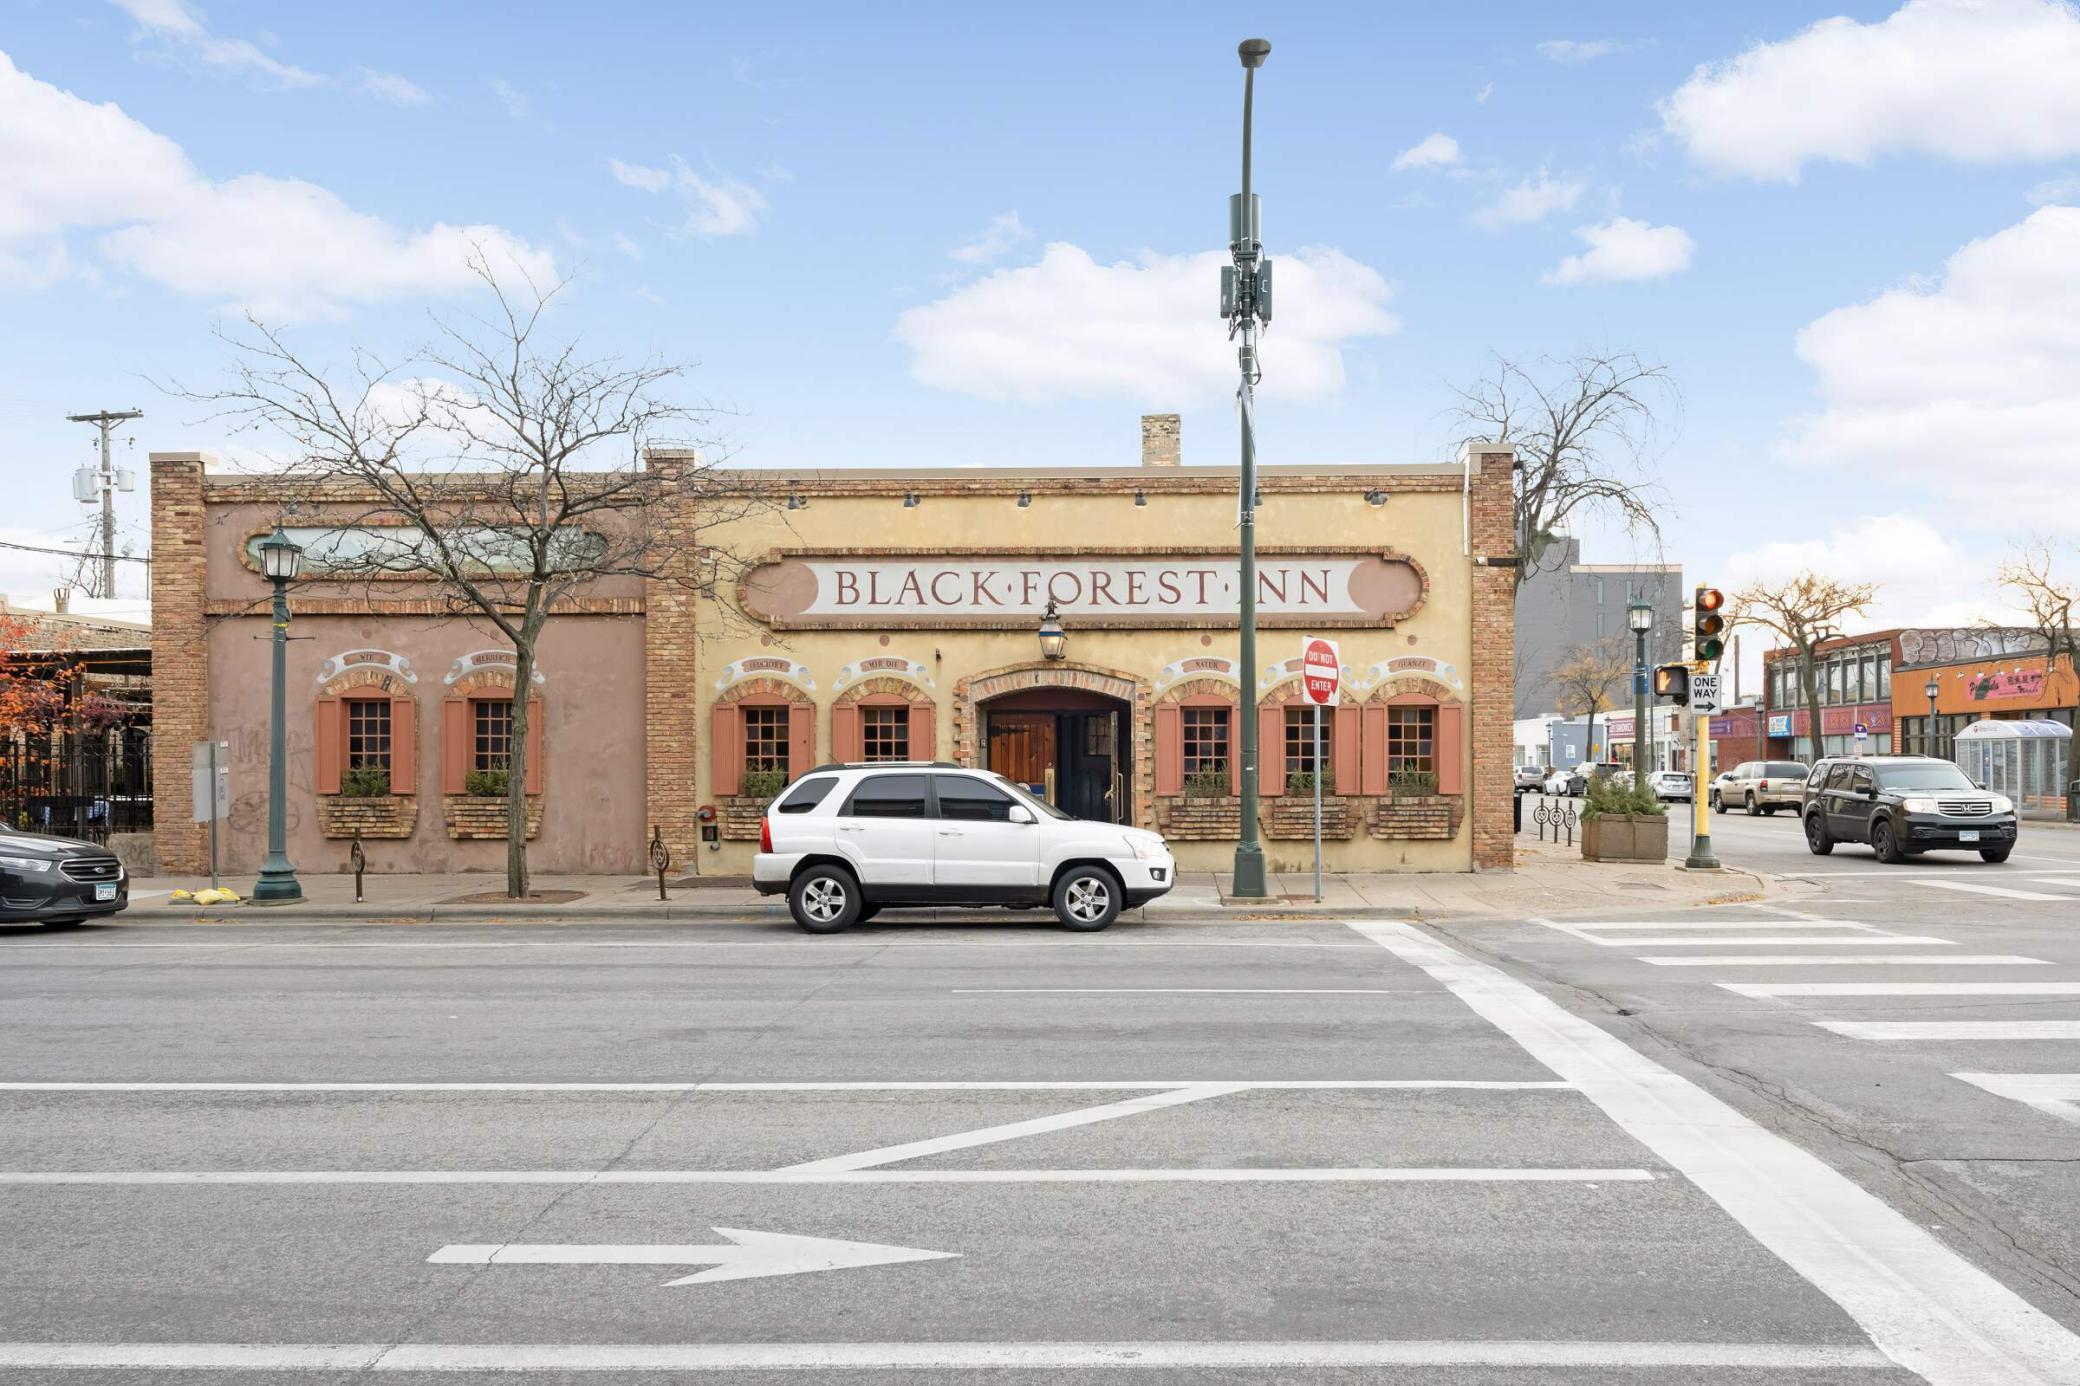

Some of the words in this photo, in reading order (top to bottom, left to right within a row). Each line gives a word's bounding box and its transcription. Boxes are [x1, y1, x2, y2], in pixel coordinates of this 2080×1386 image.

[834, 568, 1005, 606] BLACK
[1020, 569, 1218, 606] FOREST
[1308, 650, 1318, 662] DO
[1320, 652, 1333, 665] NOT
[1311, 680, 1332, 692] ENTER
[1694, 677, 1717, 687] ONE
[1694, 689, 1717, 698] WAY
